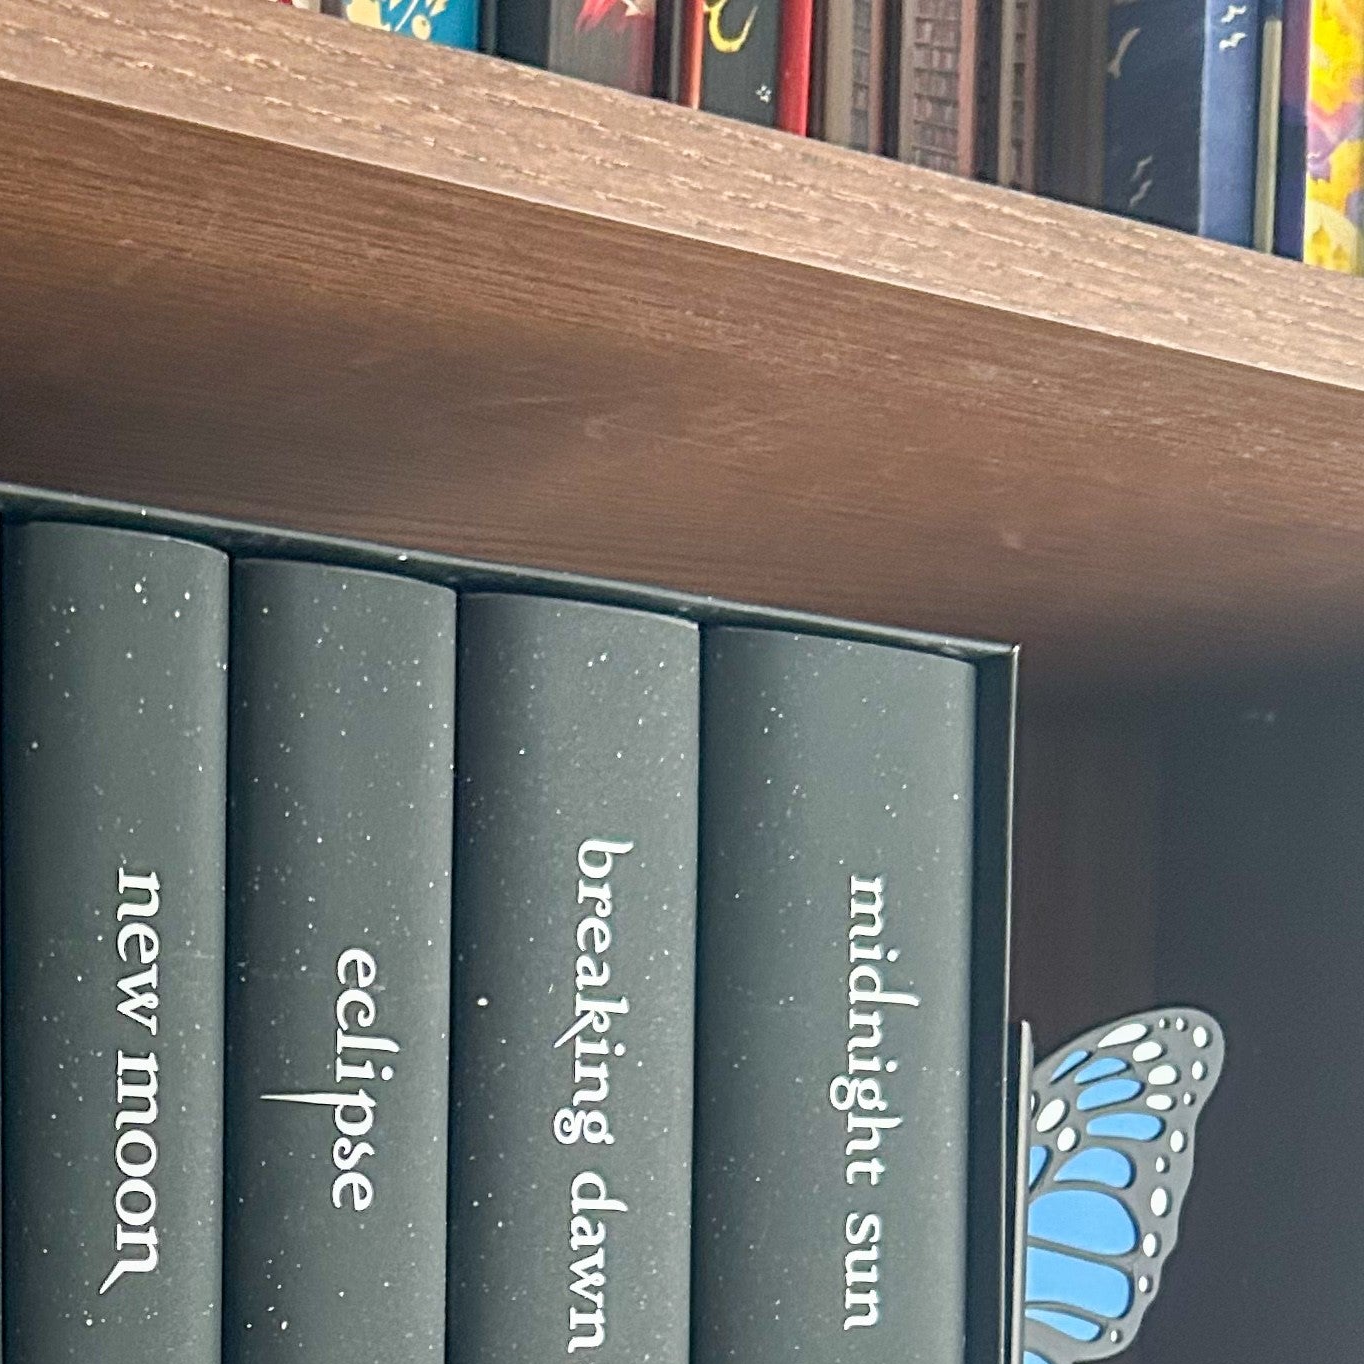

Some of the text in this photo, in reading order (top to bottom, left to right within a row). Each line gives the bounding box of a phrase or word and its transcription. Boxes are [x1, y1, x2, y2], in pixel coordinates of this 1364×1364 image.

[99, 866, 161, 1295] new moon
[260, 947, 406, 1212] eclipse
[553, 837, 634, 1354] breaking dawn
[829, 872, 920, 1331] midnight sun
